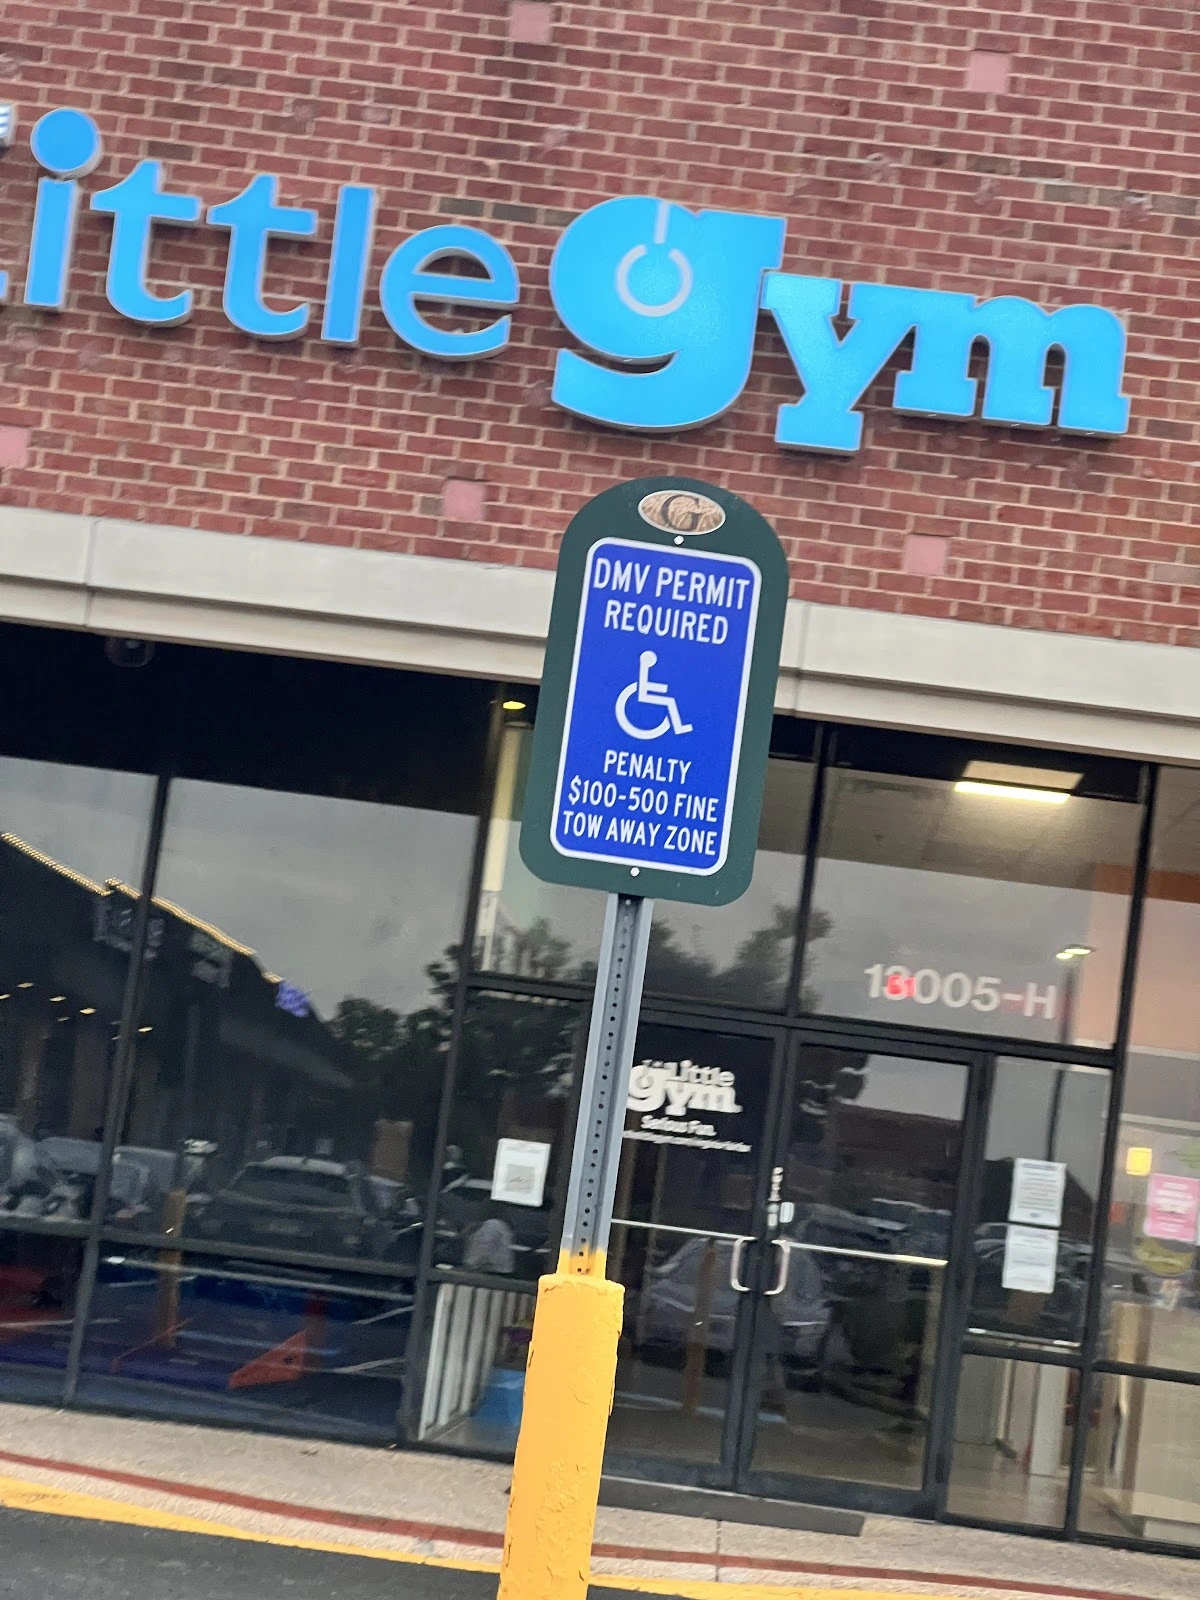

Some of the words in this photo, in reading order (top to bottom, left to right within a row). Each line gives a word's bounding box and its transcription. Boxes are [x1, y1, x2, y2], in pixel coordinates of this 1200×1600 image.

[0, 107, 521, 361] ittle
[549, 195, 1131, 456] gym
[594, 558, 652, 595] DMV
[656, 567, 750, 610] PERMIT
[604, 600, 729, 645] REQUIRED
[604, 749, 692, 785] PENALTY
[568, 775, 667, 815] $100-500
[673, 797, 719, 823] FINE
[563, 810, 602, 839] TOW
[605, 818, 660, 848] AWAY
[664, 825, 717, 855] ZONE
[864, 963, 1057, 1019] 13005-H
